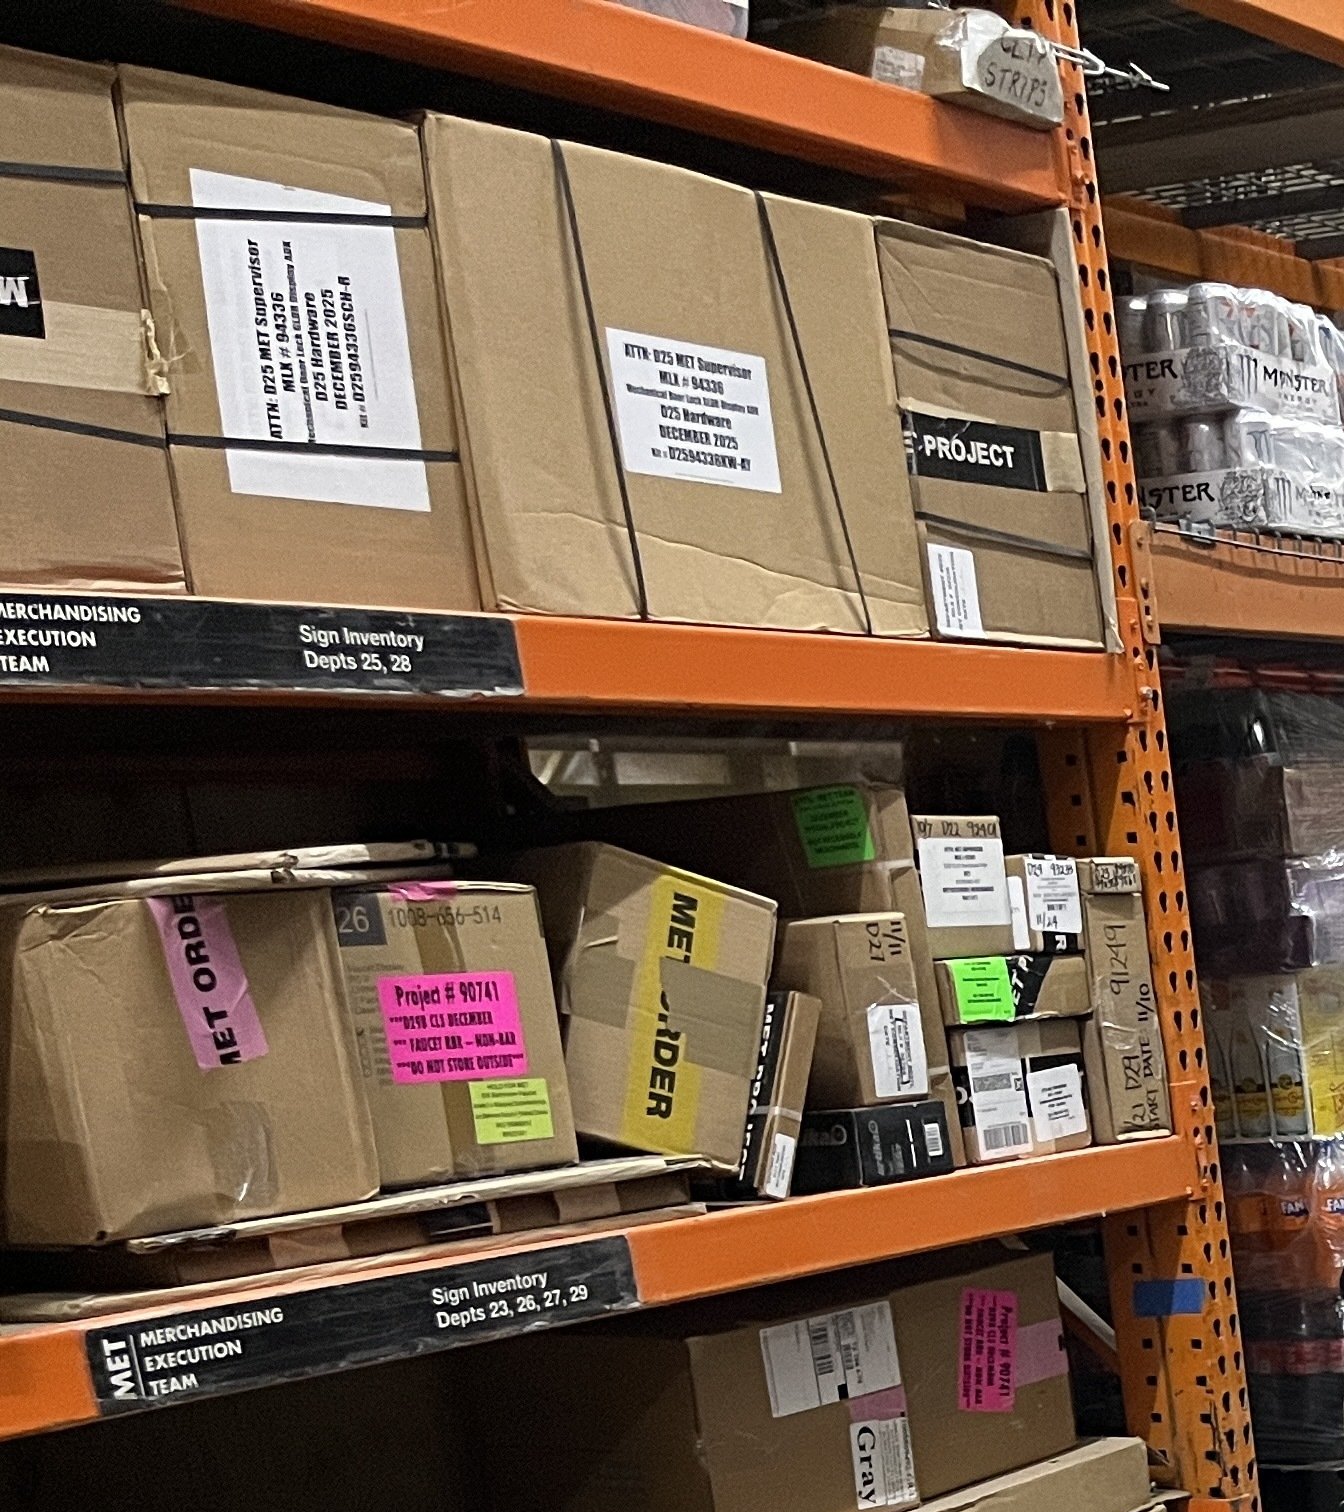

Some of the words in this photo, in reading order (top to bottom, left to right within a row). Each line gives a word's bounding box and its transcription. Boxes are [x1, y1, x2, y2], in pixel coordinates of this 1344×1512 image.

[985, 62, 1048, 107] STRIPS
[247, 238, 269, 326] Supervisor
[270, 292, 290, 343] 94336
[321, 288, 338, 328] 2025
[304, 292, 326, 368] Hardware
[260, 331, 273, 361] MET
[263, 365, 277, 396] D25
[330, 331, 349, 411] DECEMBER
[676, 353, 695, 370] MET
[697, 356, 752, 380] Supervisor
[1262, 366, 1330, 397] MONSTER
[315, 371, 329, 402] D25
[691, 376, 725, 395] 94336
[660, 405, 681, 421] D25
[682, 408, 732, 429] Hardware
[659, 424, 711, 446] DECEMBER
[713, 433, 739, 450] 2025
[923, 434, 1015, 468] PROJECT
[299, 624, 340, 648] Sign
[343, 627, 424, 653] Inventory
[0, 653, 50, 673] TEAM
[303, 650, 358, 672] Depts
[360, 653, 387, 674] 25,
[390, 655, 412, 672] 28
[339, 906, 370, 933] 26
[1103, 924, 1129, 996] 91249
[395, 985, 440, 1011] Project
[445, 982, 455, 1004] #
[460, 981, 499, 1003] 90741
[447, 1011, 493, 1027] DECEMBER
[432, 1285, 470, 1308] Sign
[473, 1271, 548, 1299] Inventory
[436, 1305, 487, 1331] Depts
[490, 1300, 514, 1320] 23,
[516, 1294, 542, 1315] 26,
[544, 1289, 566, 1310] 27,
[568, 1285, 588, 1302] 29
[140, 1307, 283, 1348] MERCHANDISING
[102, 1339, 139, 1398] MET
[145, 1340, 242, 1371] EXECUTION
[149, 1373, 199, 1396] TEAM
[857, 1426, 876, 1504] Gray
